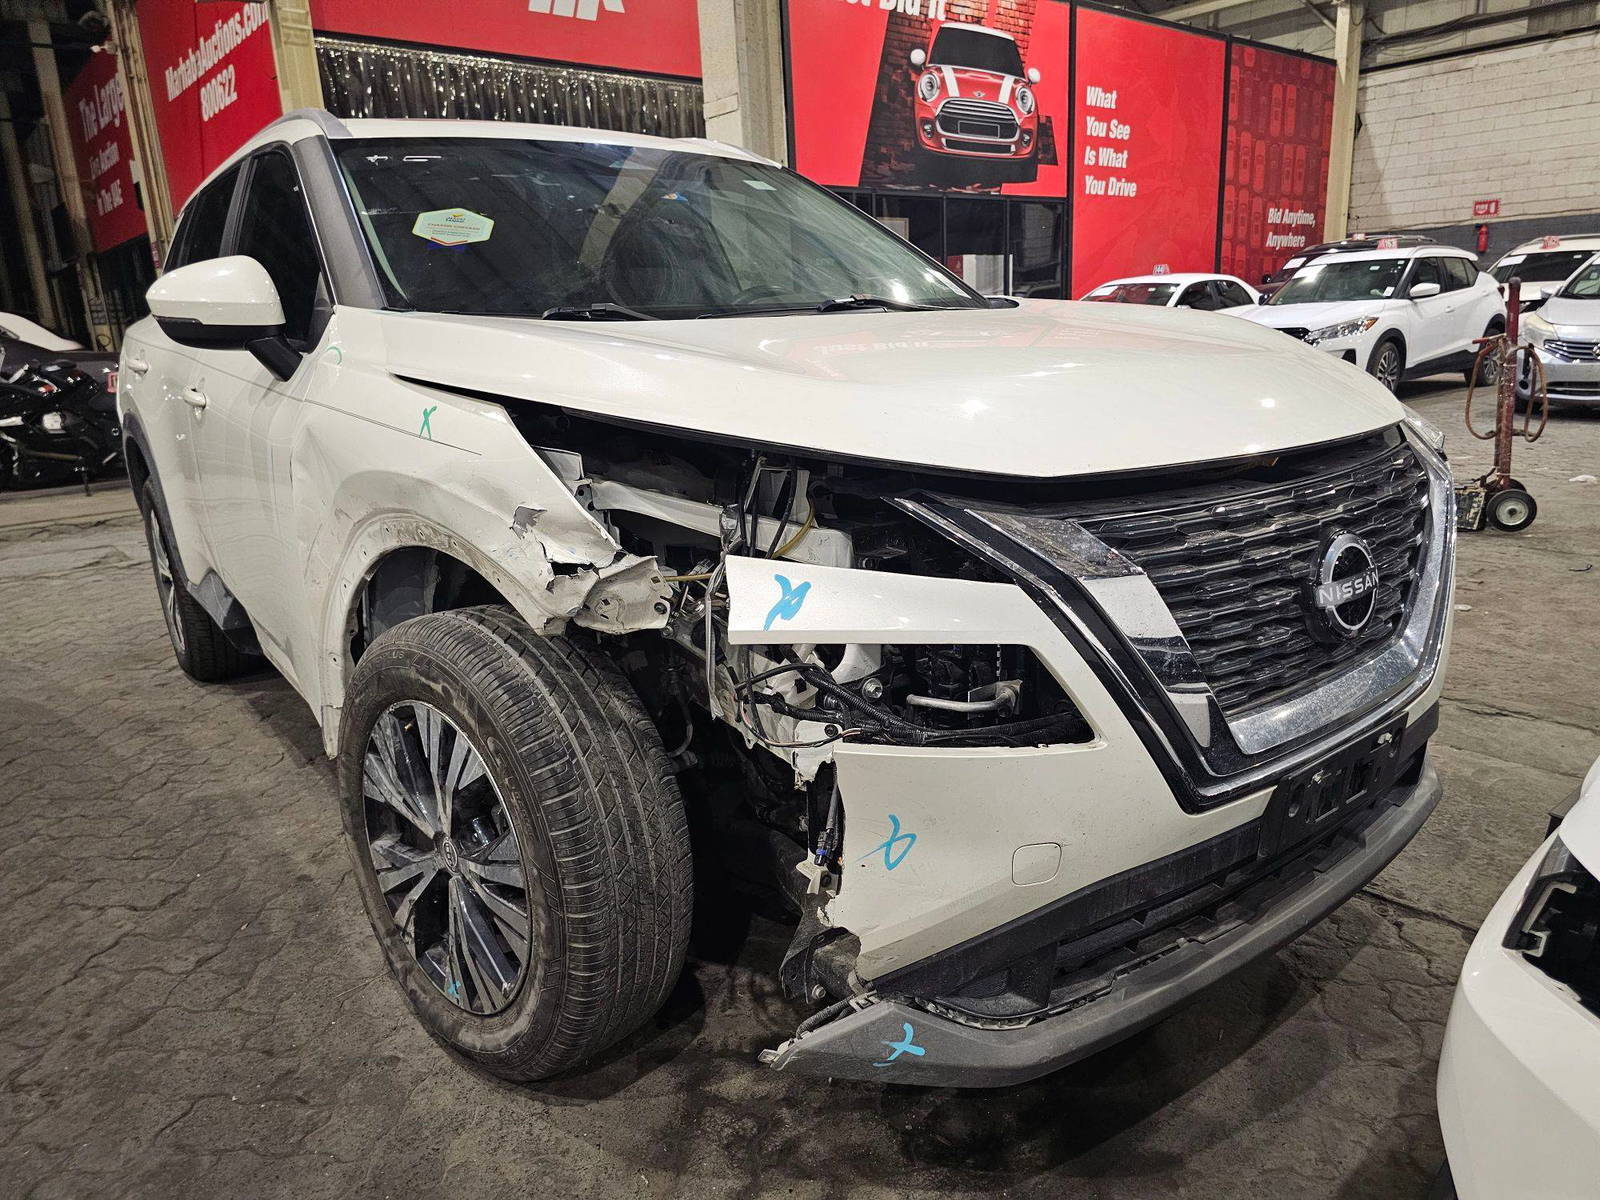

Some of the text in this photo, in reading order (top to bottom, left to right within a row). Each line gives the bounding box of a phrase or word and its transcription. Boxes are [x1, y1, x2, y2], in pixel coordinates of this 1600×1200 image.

[201, 64, 238, 122] 800622
[1086, 85, 1118, 109] What
[1086, 116, 1131, 141] You See
[1084, 146, 1128, 169] Is What
[1085, 175, 1137, 198] You Drive
[1267, 208, 1316, 228] Bid Anytime,
[1266, 232, 1305, 250] Anywhere
[1319, 572, 1378, 604] NISSAN
